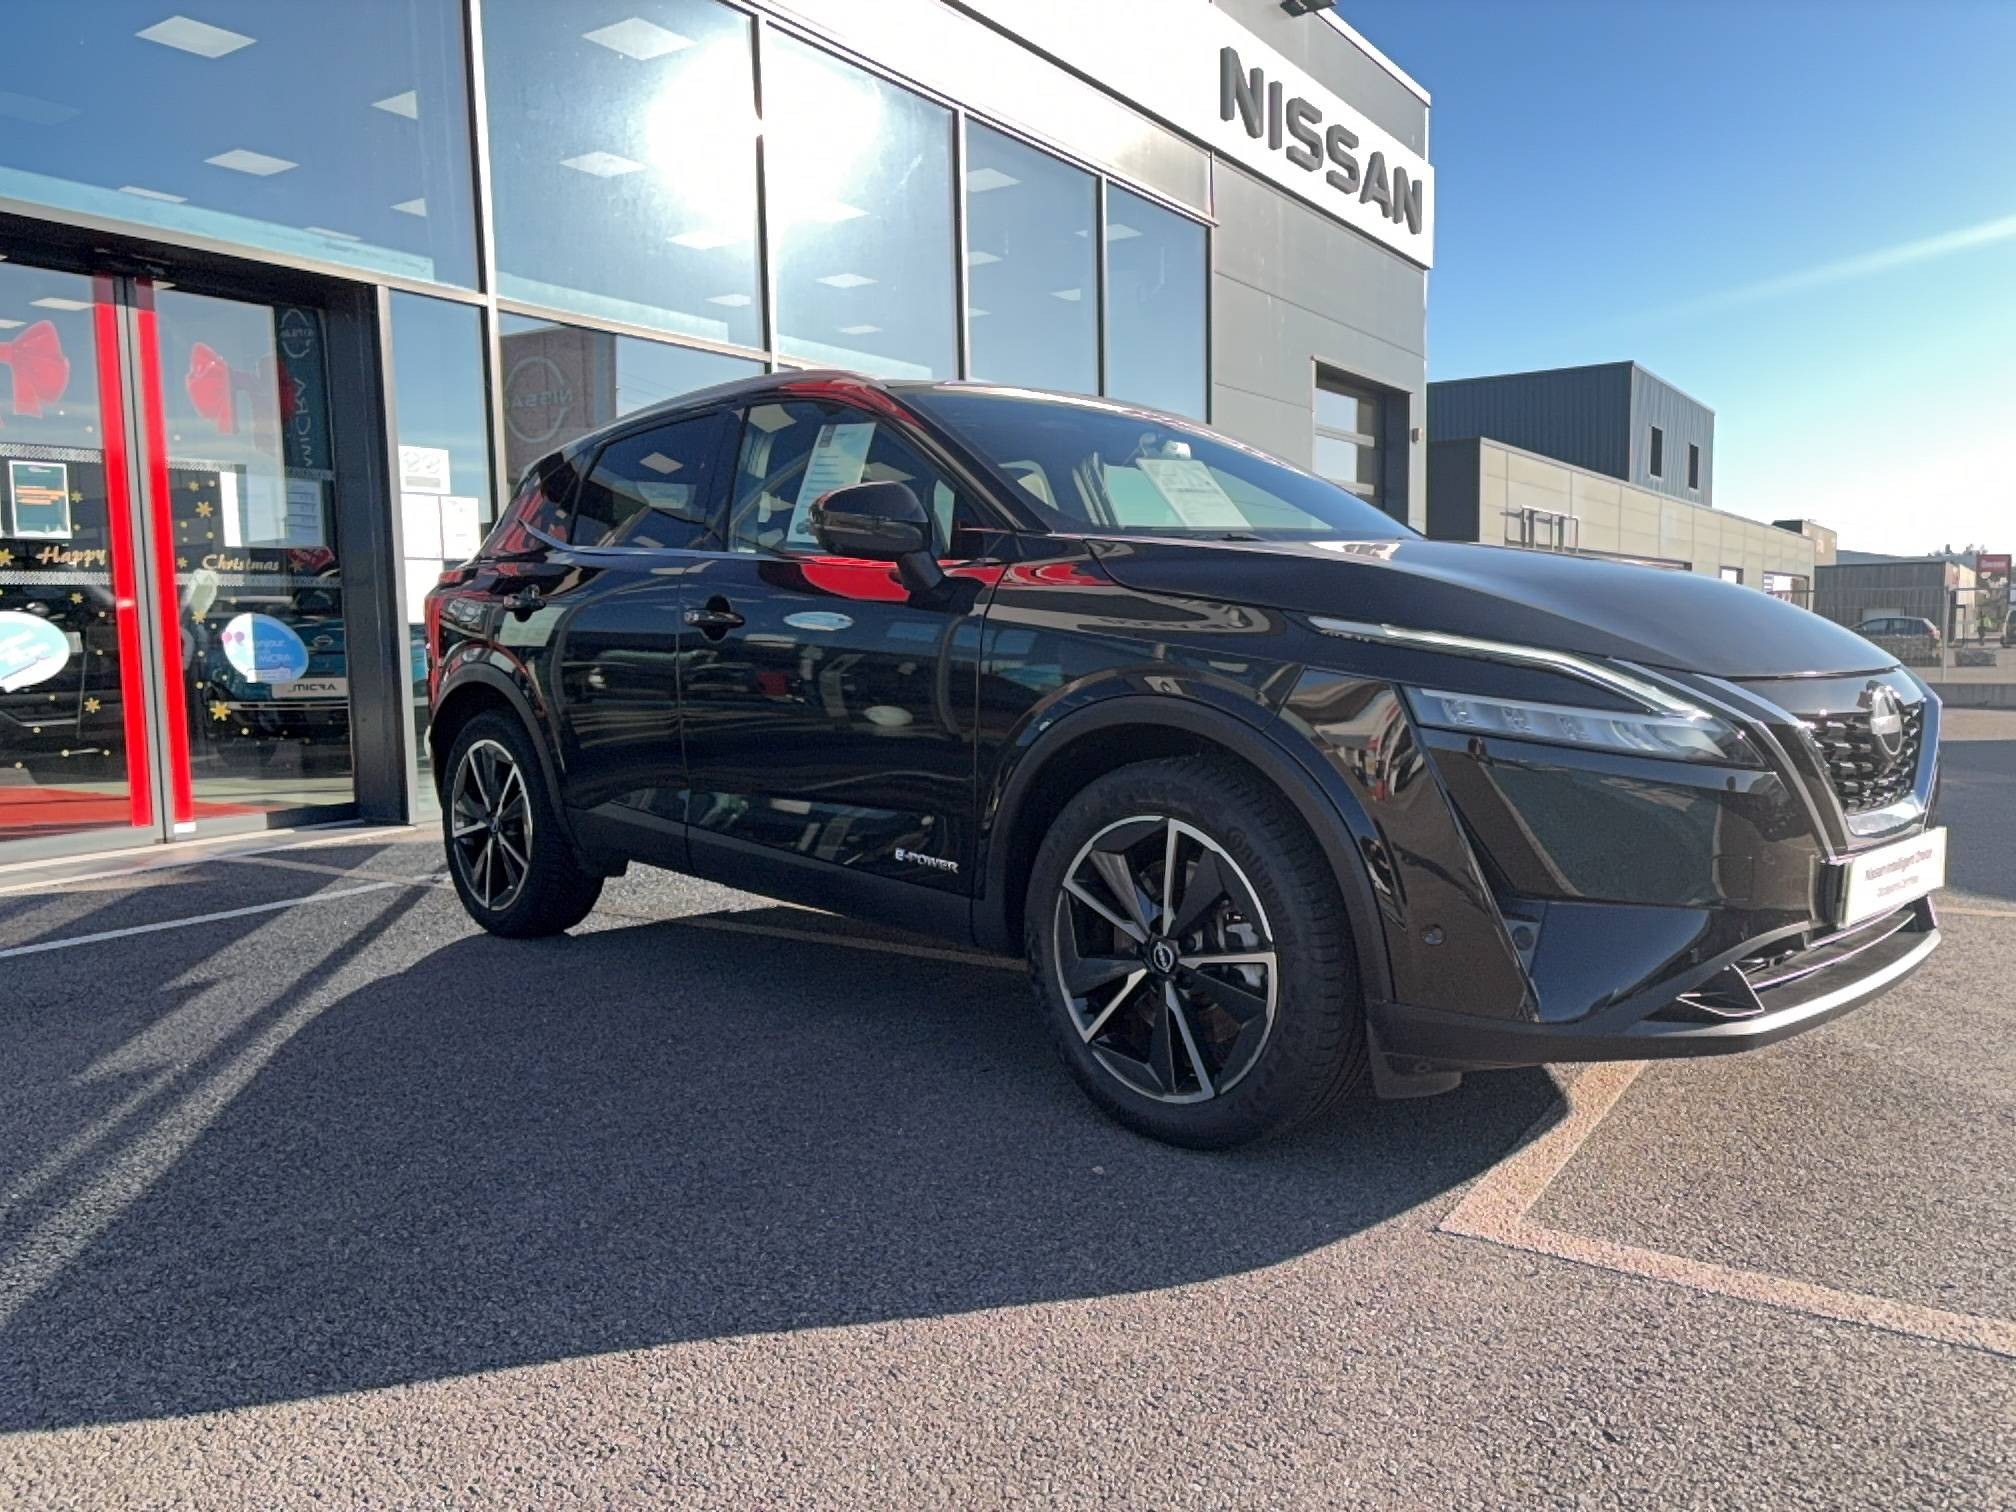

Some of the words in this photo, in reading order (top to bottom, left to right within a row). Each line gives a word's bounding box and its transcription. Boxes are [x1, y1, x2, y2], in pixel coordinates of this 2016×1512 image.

[1220, 46, 1422, 235] NISSAN
[35, 545, 106, 567] Happy
[202, 554, 279, 570] Christmas
